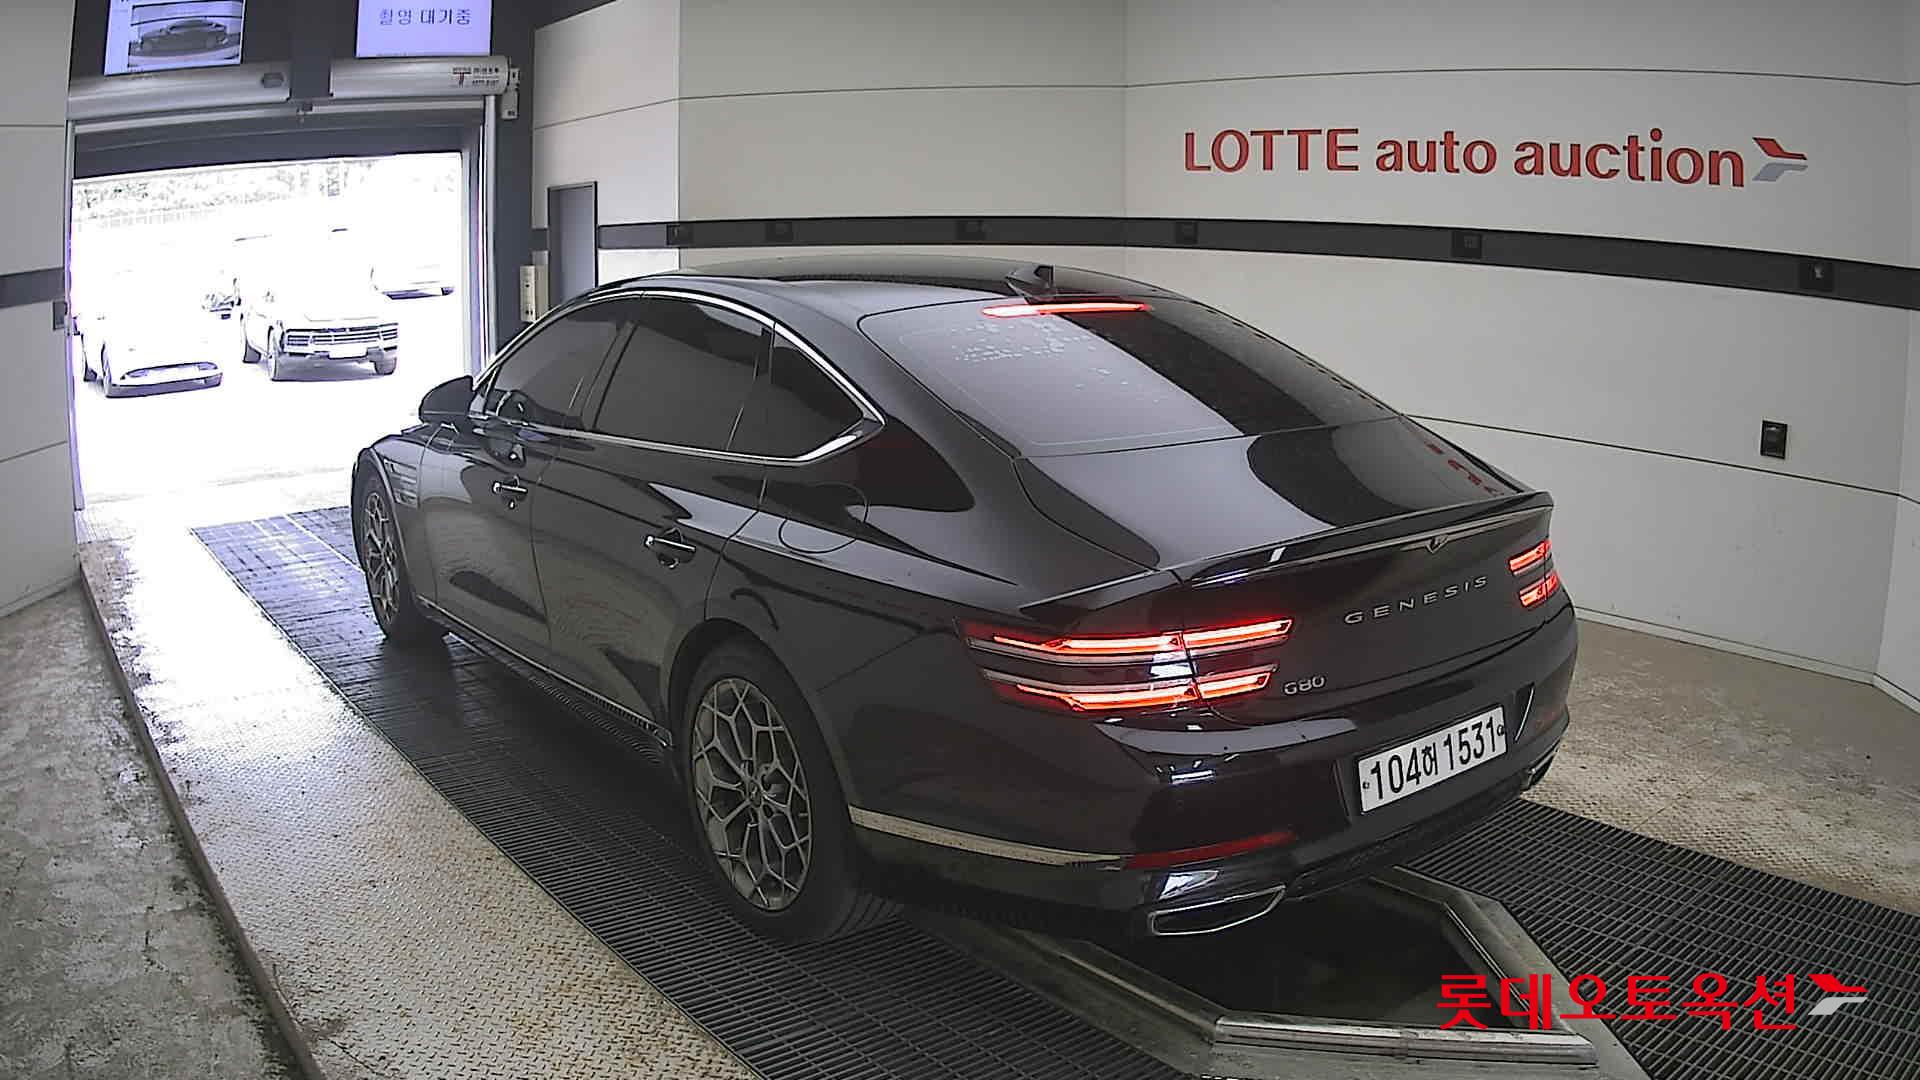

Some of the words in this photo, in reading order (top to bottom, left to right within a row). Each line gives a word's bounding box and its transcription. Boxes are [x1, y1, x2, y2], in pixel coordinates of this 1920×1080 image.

[420, 8, 472, 25] 대기중
[1184, 128, 1359, 172] LOTTE
[1375, 130, 1497, 174] auto
[1513, 127, 1744, 187] auction
[1344, 576, 1488, 624] GENESIS
[1283, 675, 1326, 695] G80
[1370, 742, 1439, 800] 104허
[1443, 716, 1496, 771] 1531
